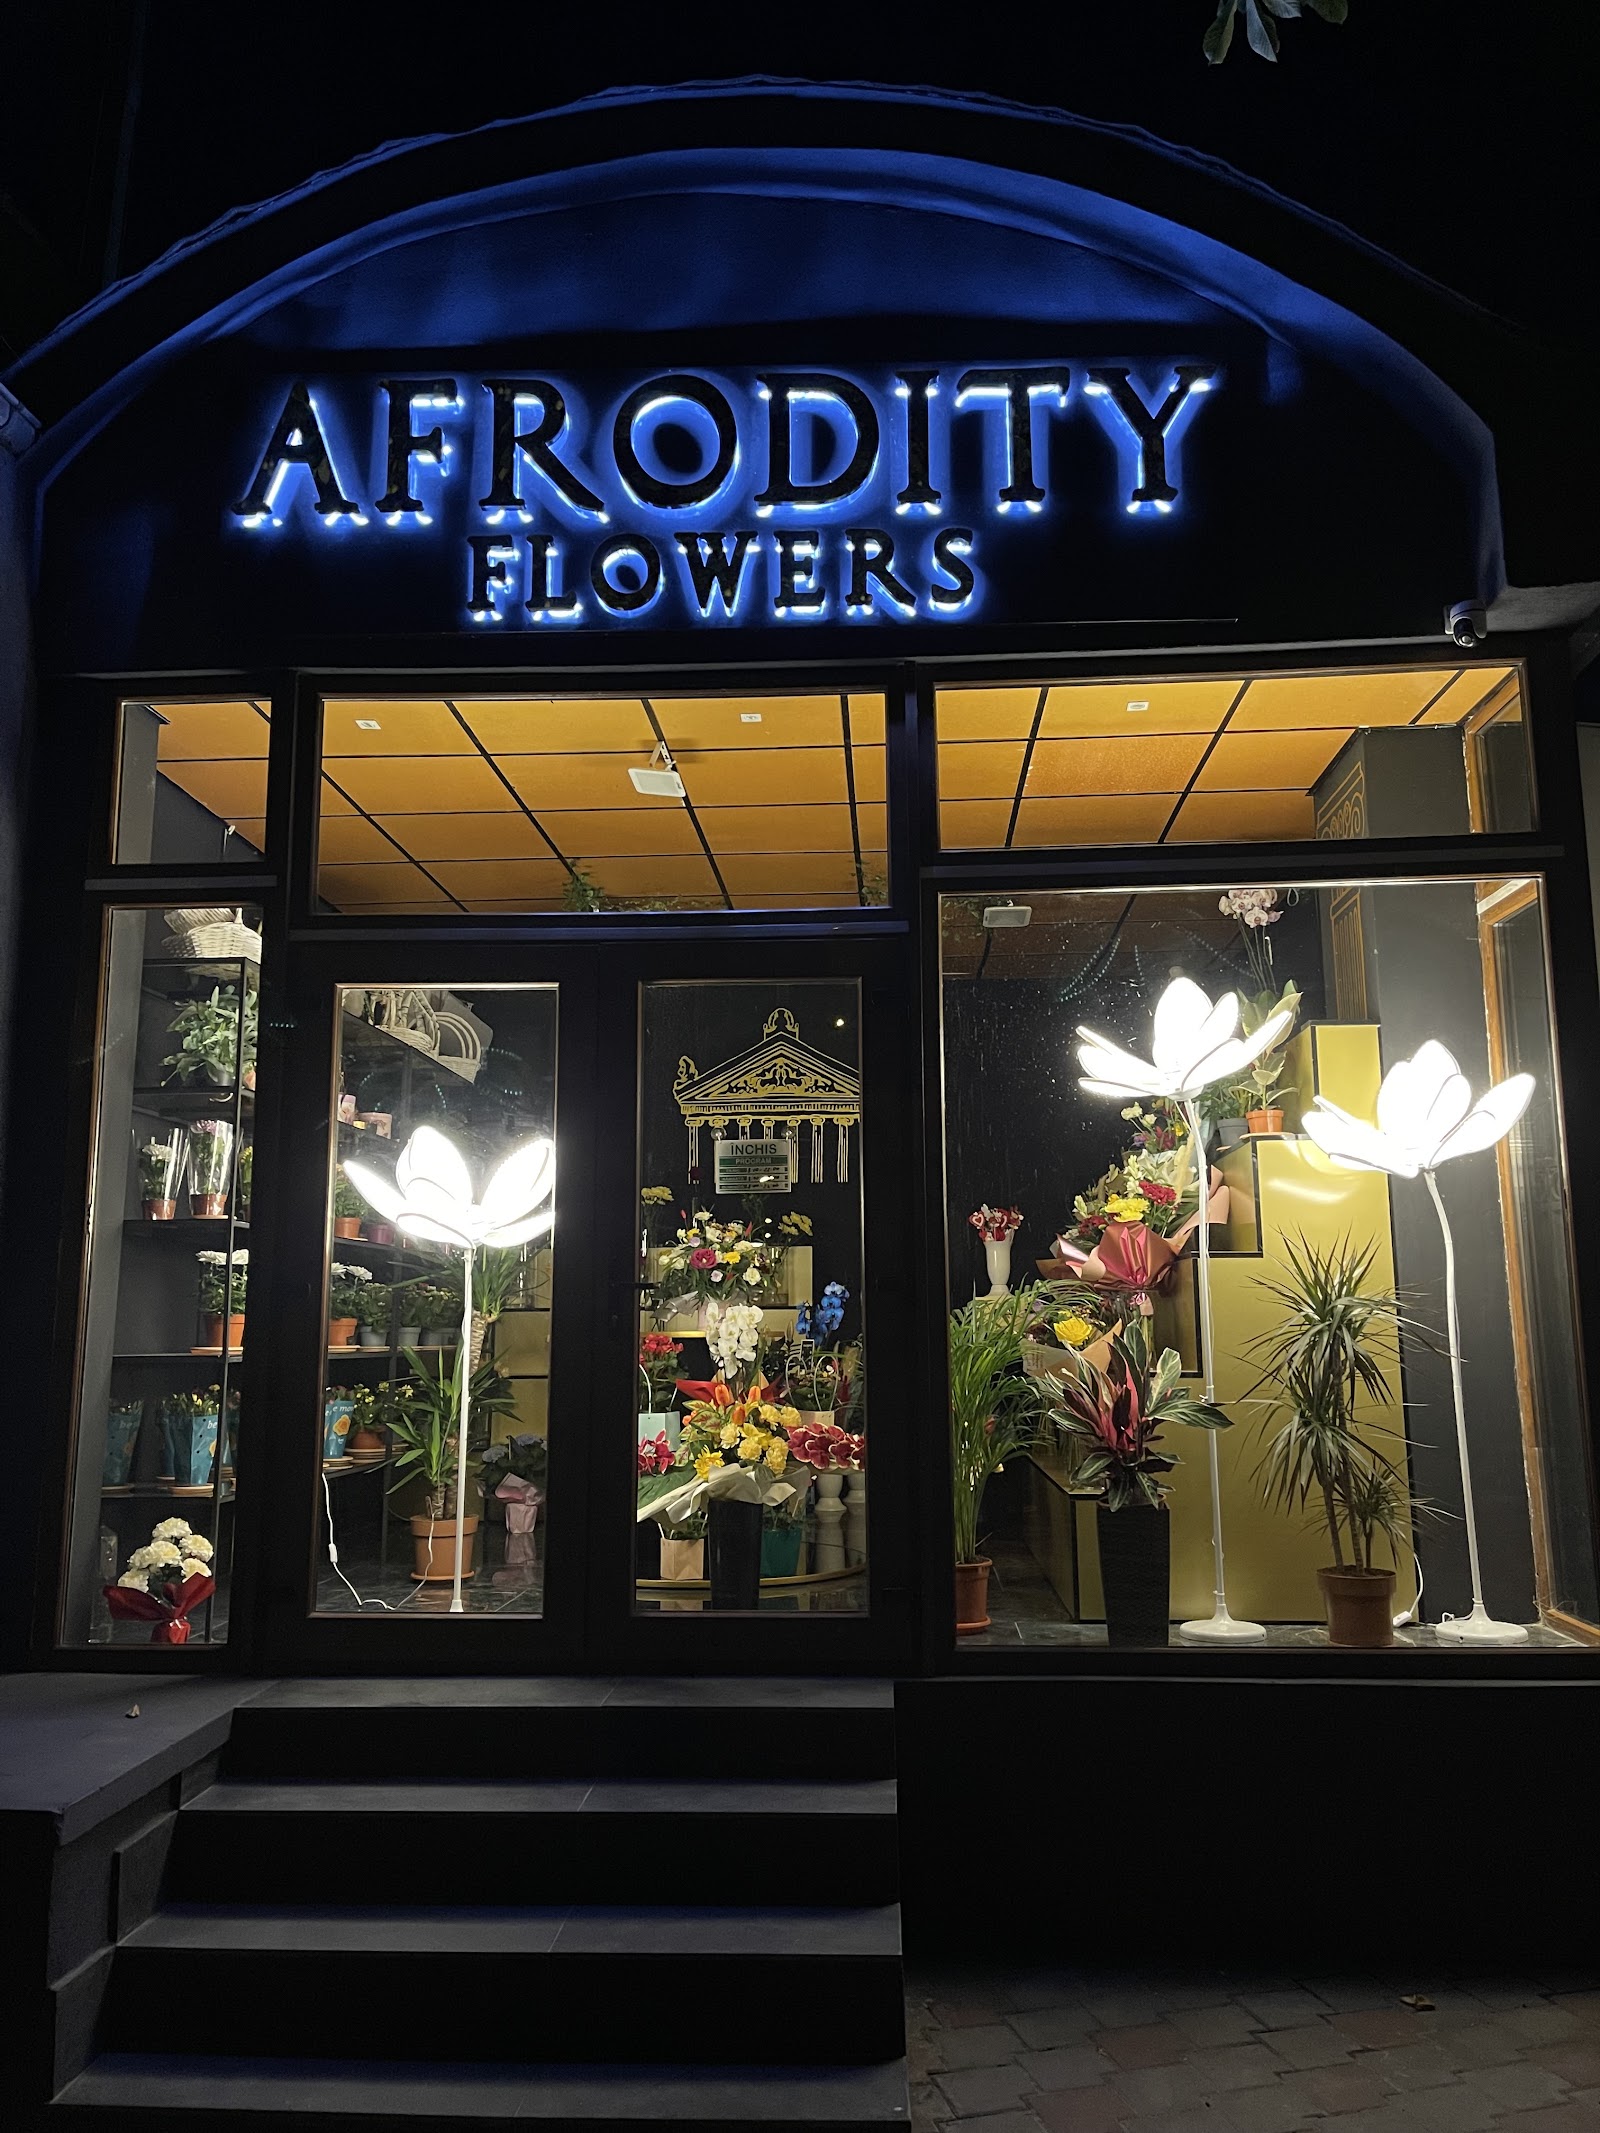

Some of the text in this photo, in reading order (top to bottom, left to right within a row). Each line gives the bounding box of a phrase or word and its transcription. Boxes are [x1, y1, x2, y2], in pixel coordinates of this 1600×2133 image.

[231, 364, 1217, 522] AFRODITY
[466, 528, 979, 618] FLOWERS
[735, 1157, 772, 1165] PROGRAM
